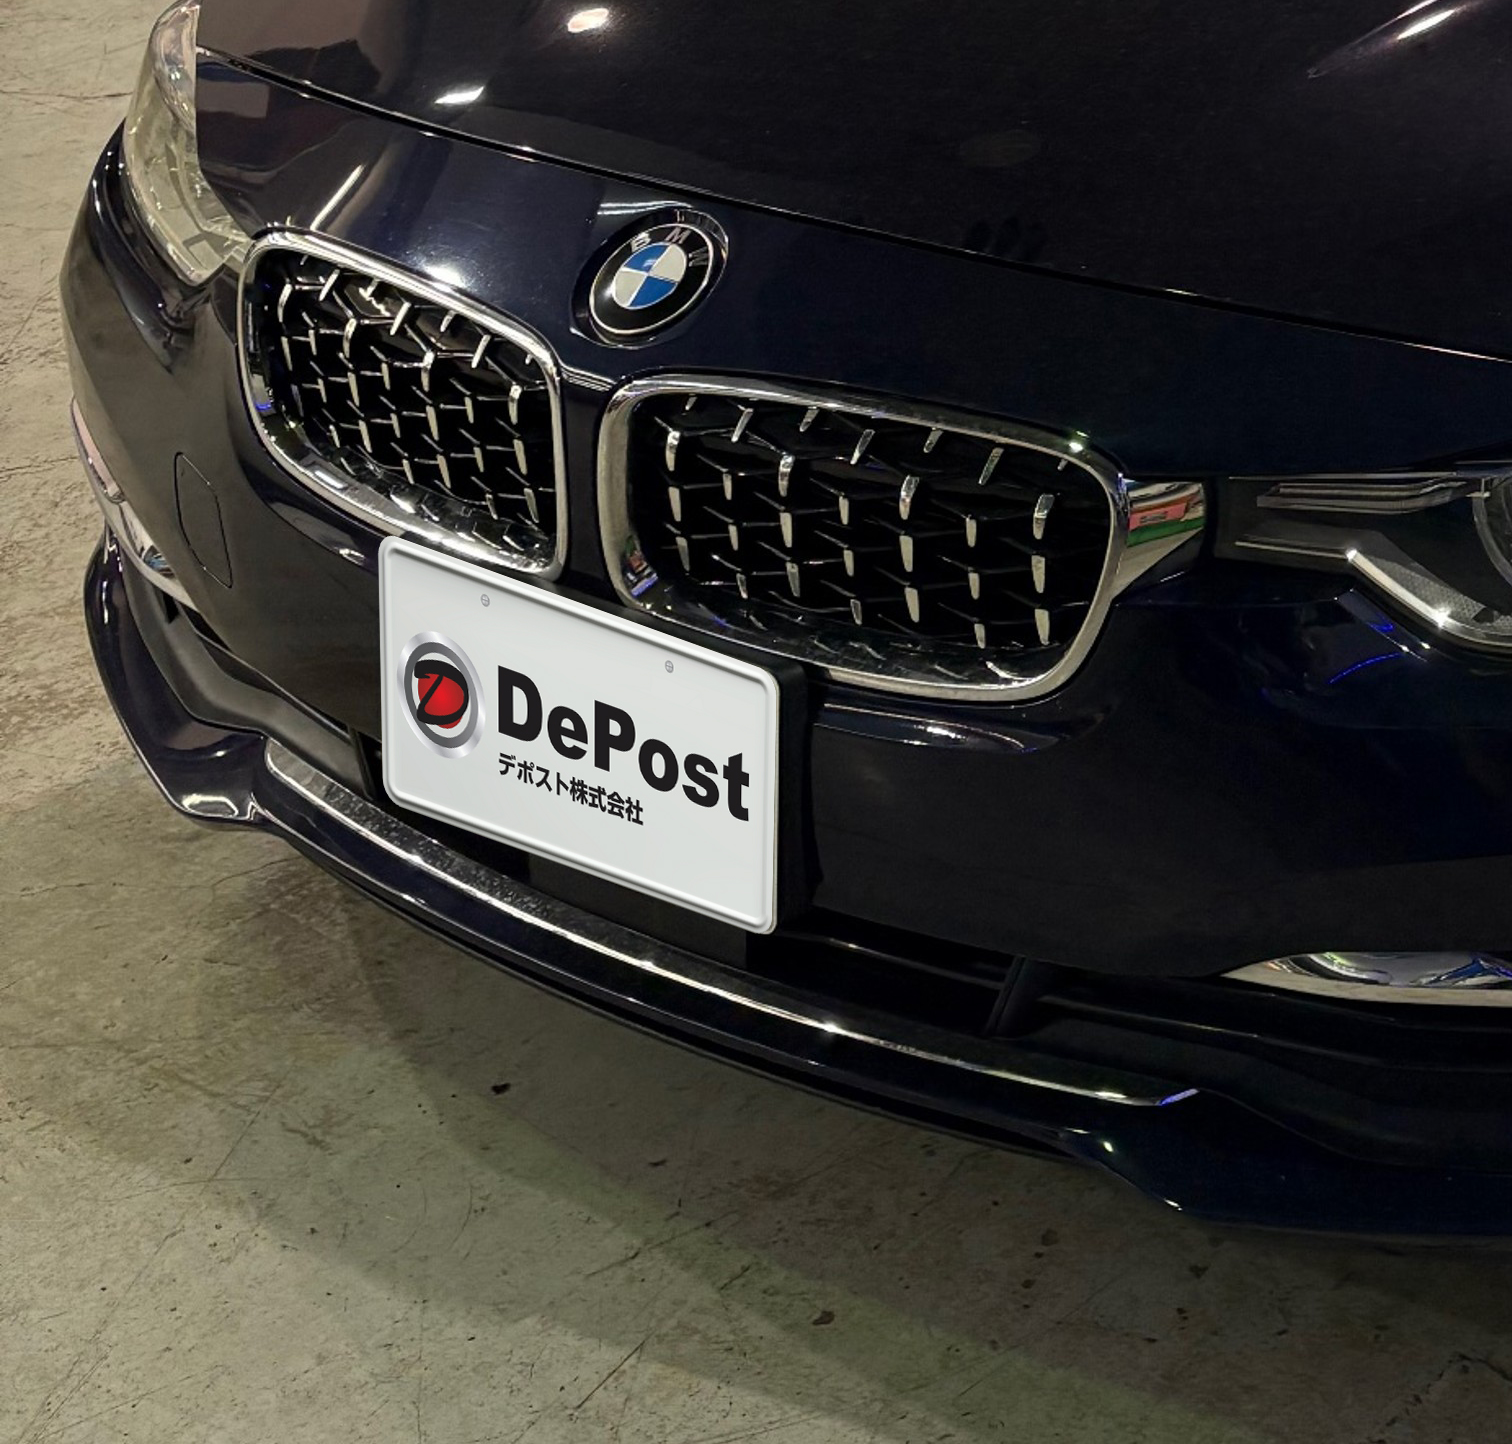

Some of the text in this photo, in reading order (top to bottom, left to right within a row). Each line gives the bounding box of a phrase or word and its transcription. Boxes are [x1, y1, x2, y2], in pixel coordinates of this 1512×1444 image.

[630, 226, 708, 267] BMW
[498, 665, 749, 821] DePost
[498, 753, 643, 825] デポスト株式会社
